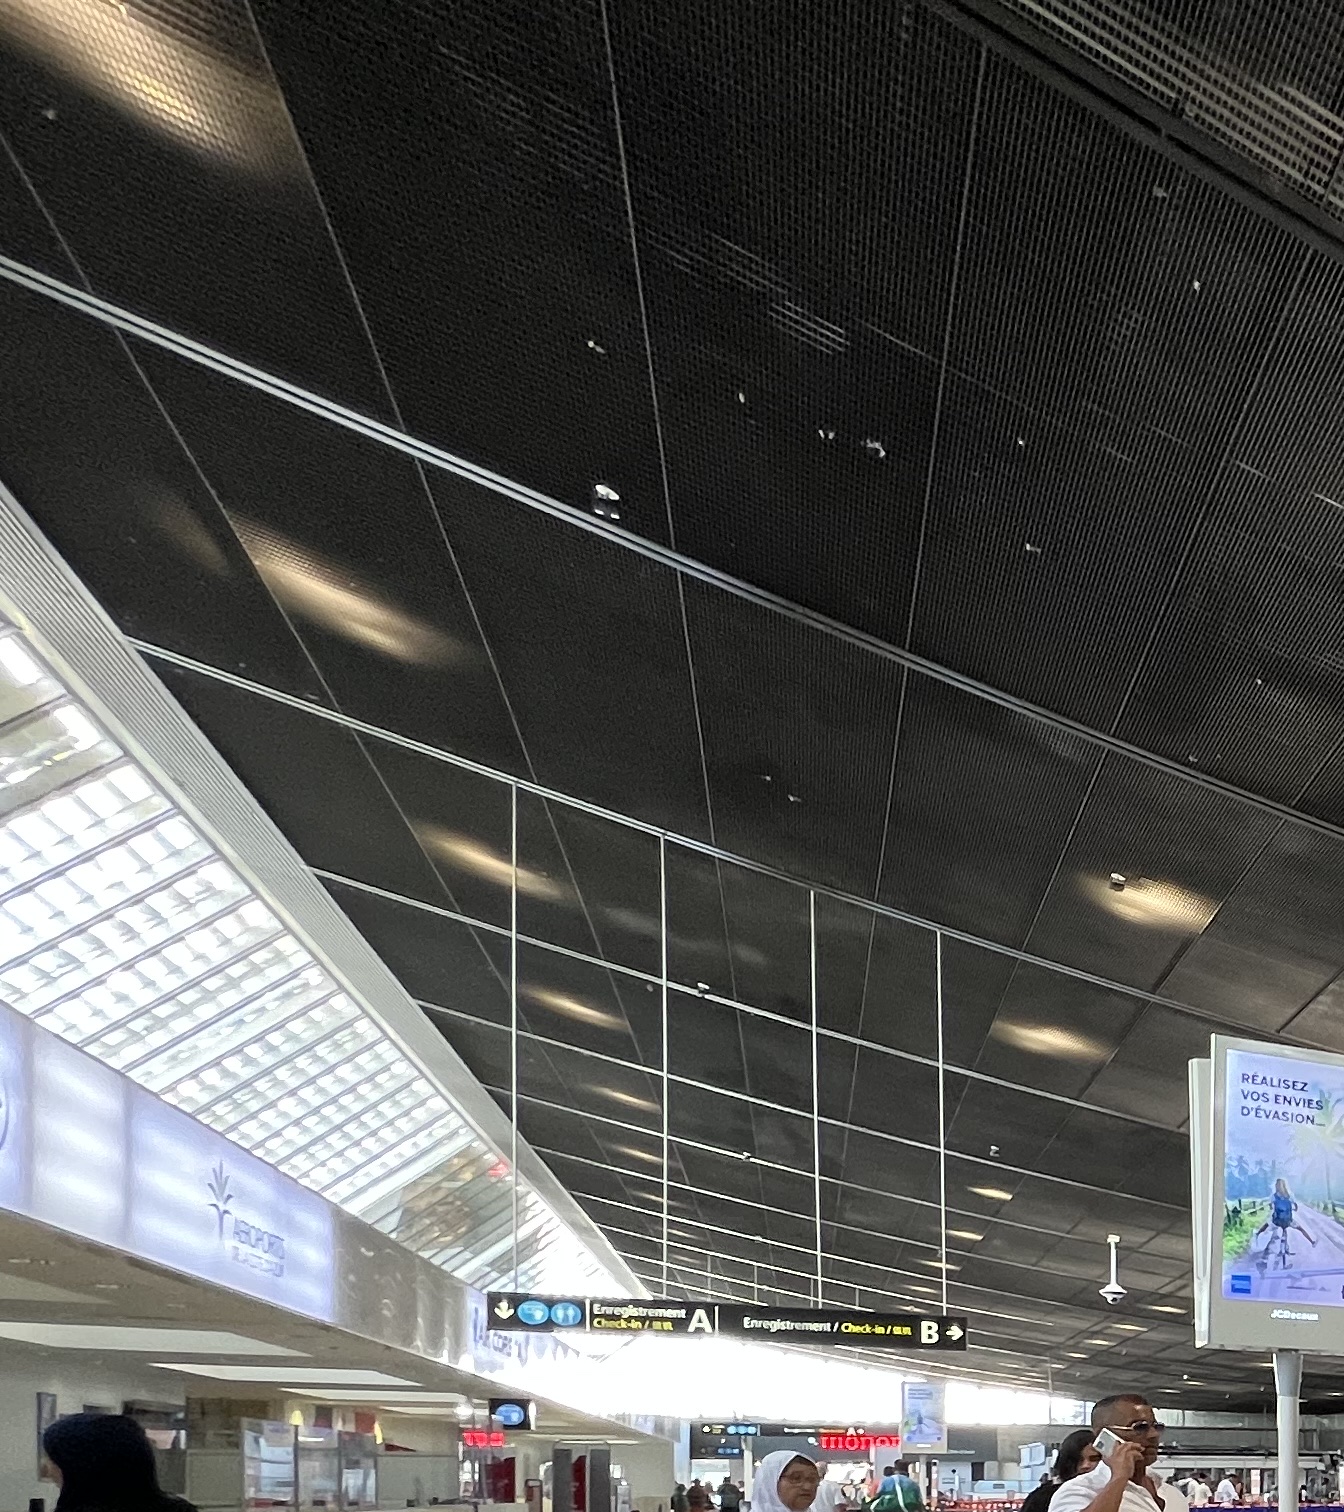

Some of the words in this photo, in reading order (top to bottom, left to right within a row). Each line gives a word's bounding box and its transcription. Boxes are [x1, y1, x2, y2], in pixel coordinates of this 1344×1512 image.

[1241, 1072, 1309, 1092] RÉALISEZ
[1240, 1089, 1270, 1103] VOS
[1274, 1094, 1324, 1111] ENVIES
[592, 1303, 687, 1319] Enregistrement
[687, 1308, 713, 1333] A
[743, 1316, 832, 1333] Enregistrement
[840, 1322, 885, 1335] Check-in
[920, 1320, 940, 1344] B
